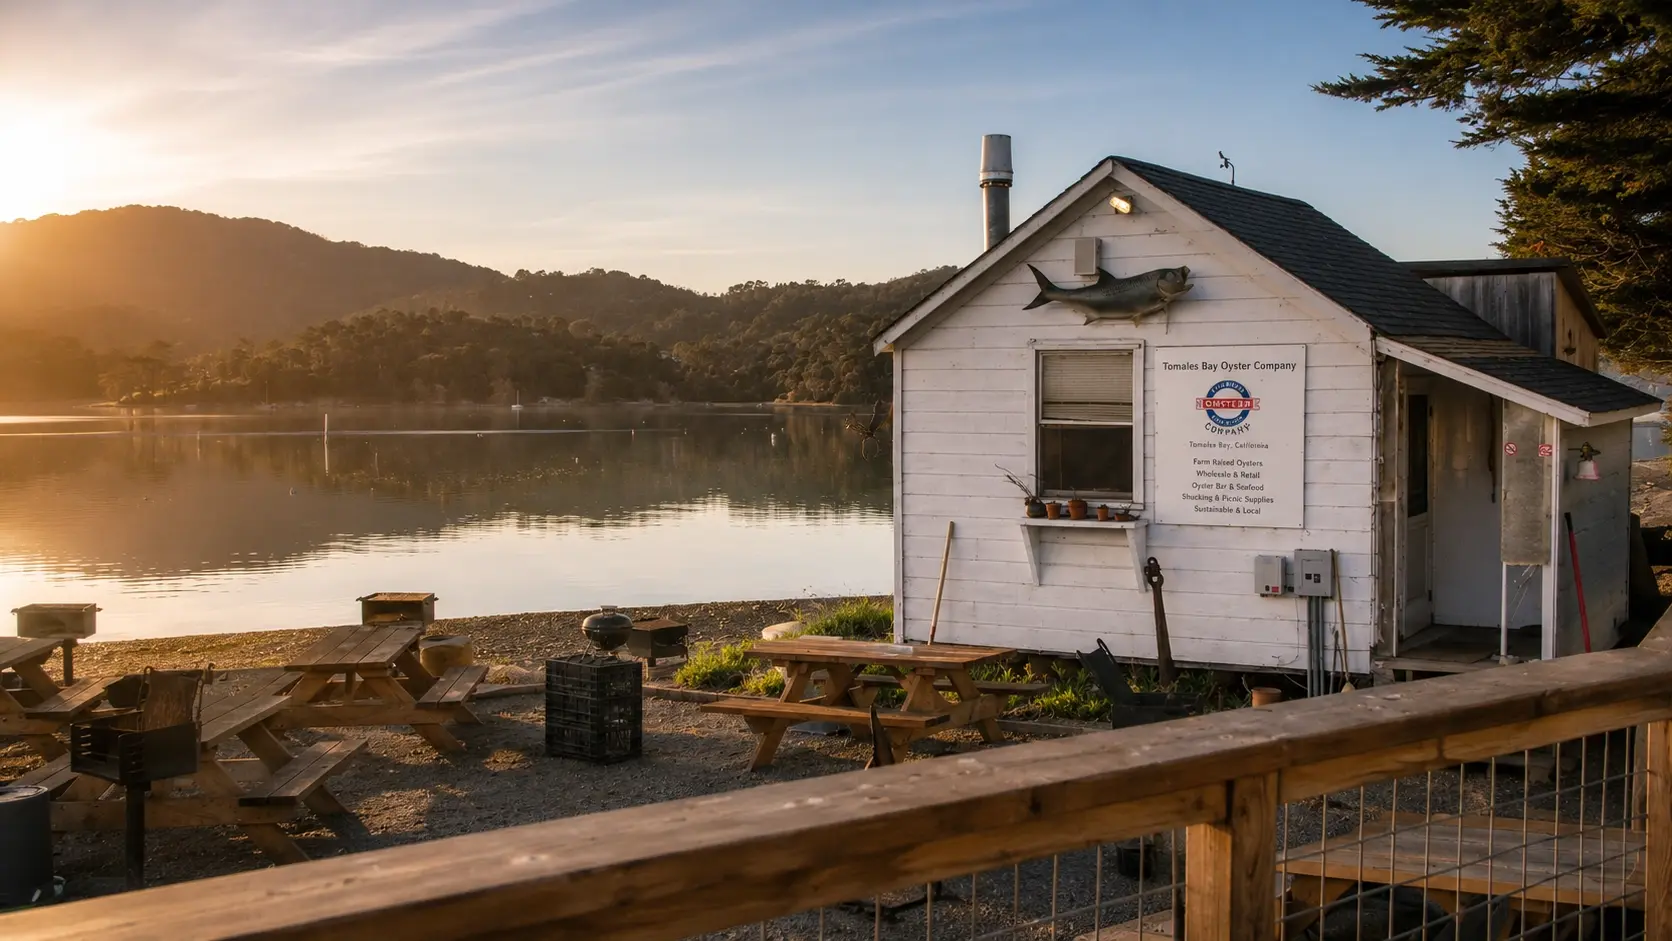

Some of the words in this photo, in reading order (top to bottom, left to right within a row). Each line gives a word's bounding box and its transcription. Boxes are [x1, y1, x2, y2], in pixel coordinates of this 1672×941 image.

[1163, 361, 1199, 371] Tomales
[1201, 362, 1218, 373] Bay
[1220, 361, 1251, 373] Oyster
[1253, 361, 1297, 372] Company
[1193, 458, 1211, 466] Farm
[1212, 459, 1235, 467] Raised
[1236, 459, 1264, 469] Oysters
[1196, 470, 1232, 479] Wholesale
[1233, 471, 1239, 479] &
[1240, 471, 1261, 479] Retail
[1191, 482, 1214, 491] Oyster
[1229, 483, 1235, 491] &
[1236, 483, 1265, 491] Seafood
[1182, 493, 1213, 503] Shucking
[1214, 494, 1220, 502] &
[1222, 495, 1243, 503] Picnic
[1244, 496, 1275, 505] Supplies
[1194, 505, 1234, 514] Sustainable
[1242, 507, 1261, 515] Local
